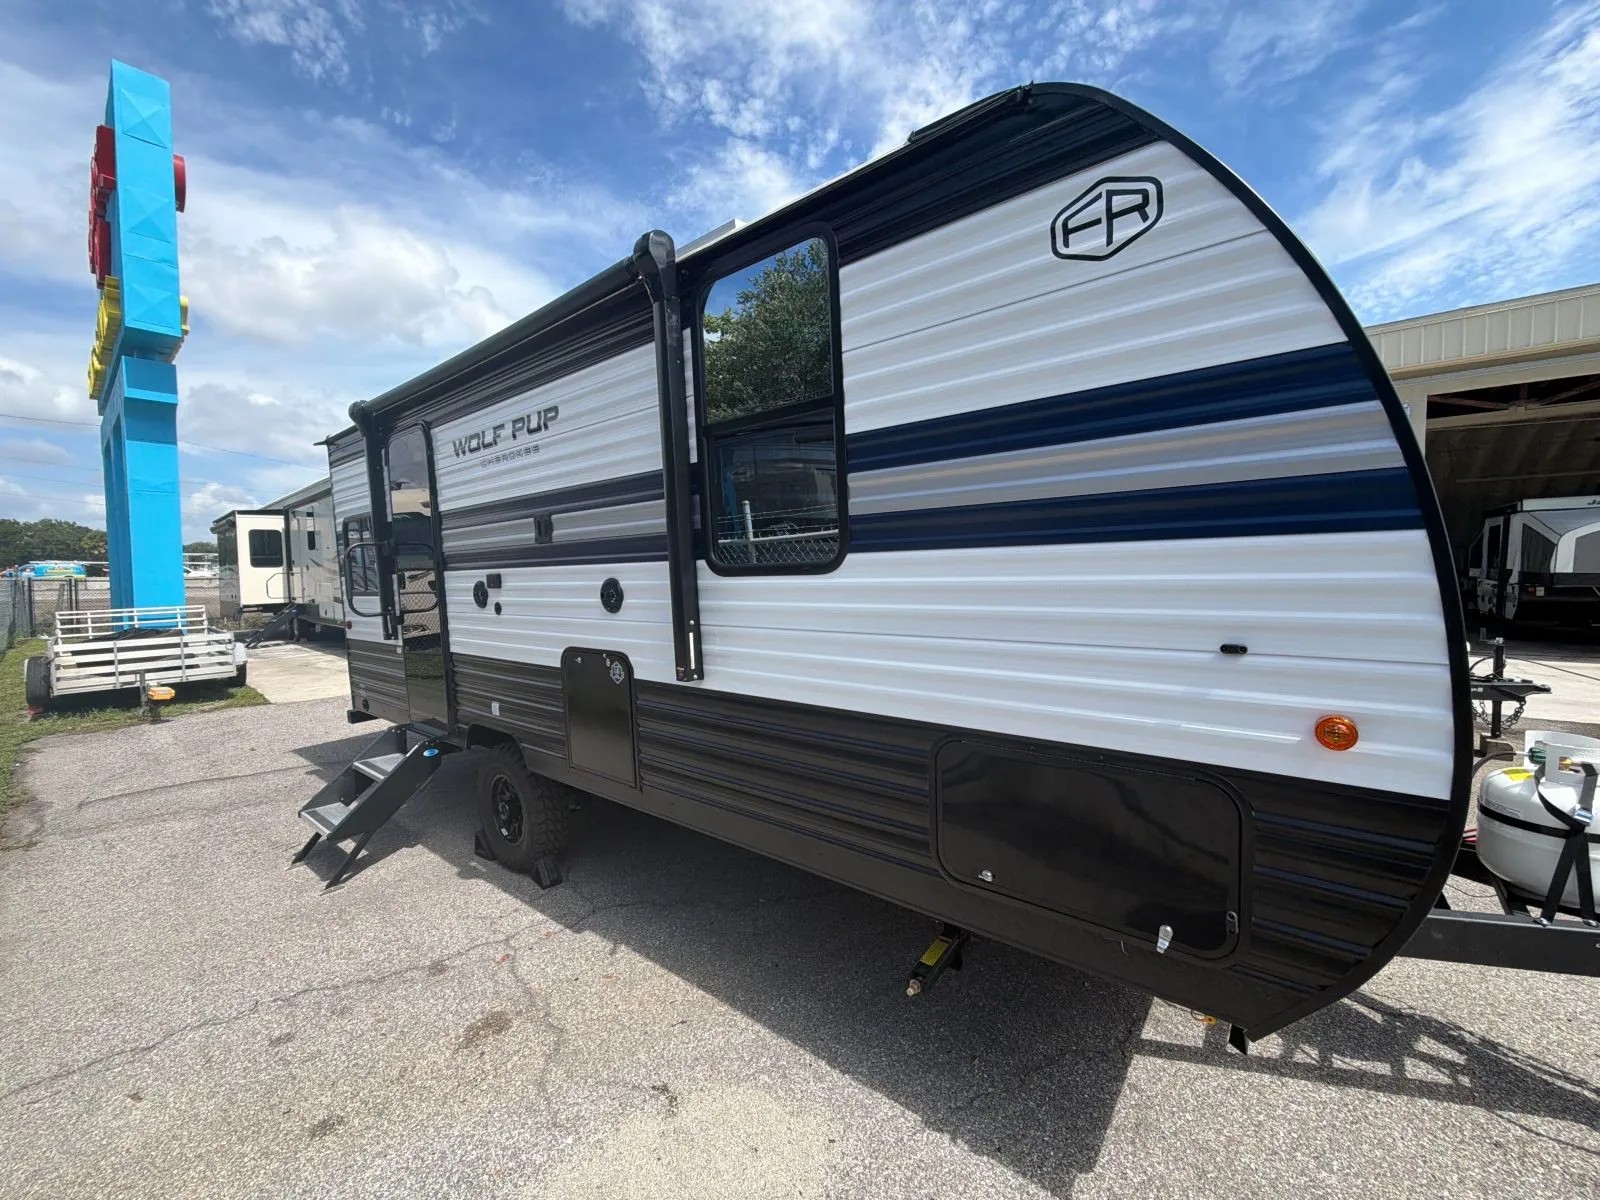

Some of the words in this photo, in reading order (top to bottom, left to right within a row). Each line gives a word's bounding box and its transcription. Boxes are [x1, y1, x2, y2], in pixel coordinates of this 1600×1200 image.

[452, 424, 505, 458] WOLF
[511, 405, 559, 441] PUP
[480, 444, 540, 467] CHEROKEE
